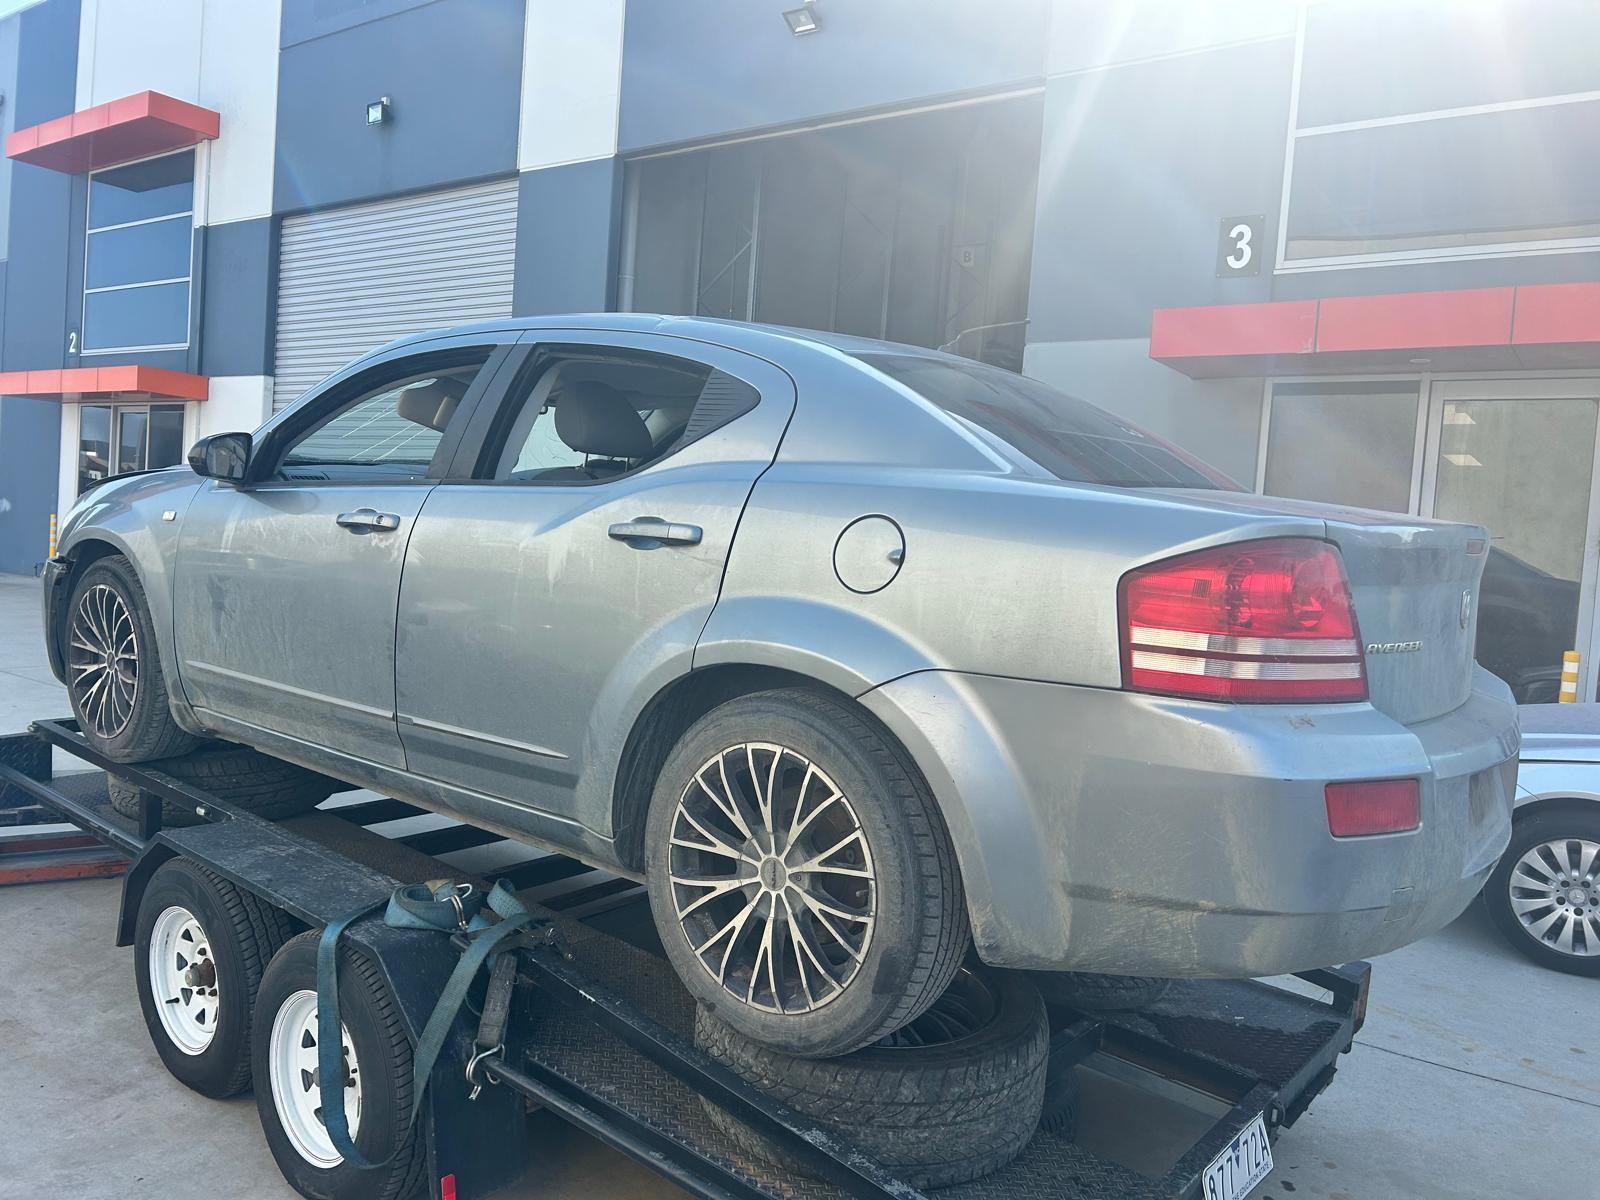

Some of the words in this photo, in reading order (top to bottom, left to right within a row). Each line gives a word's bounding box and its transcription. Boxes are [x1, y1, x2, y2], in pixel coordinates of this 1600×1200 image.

[1226, 224, 1252, 269] 3
[68, 331, 77, 353] 2
[1366, 640, 1423, 655] AVENGER
[1208, 1155, 1234, 1200] 877
[1242, 1123, 1270, 1176] 72A
